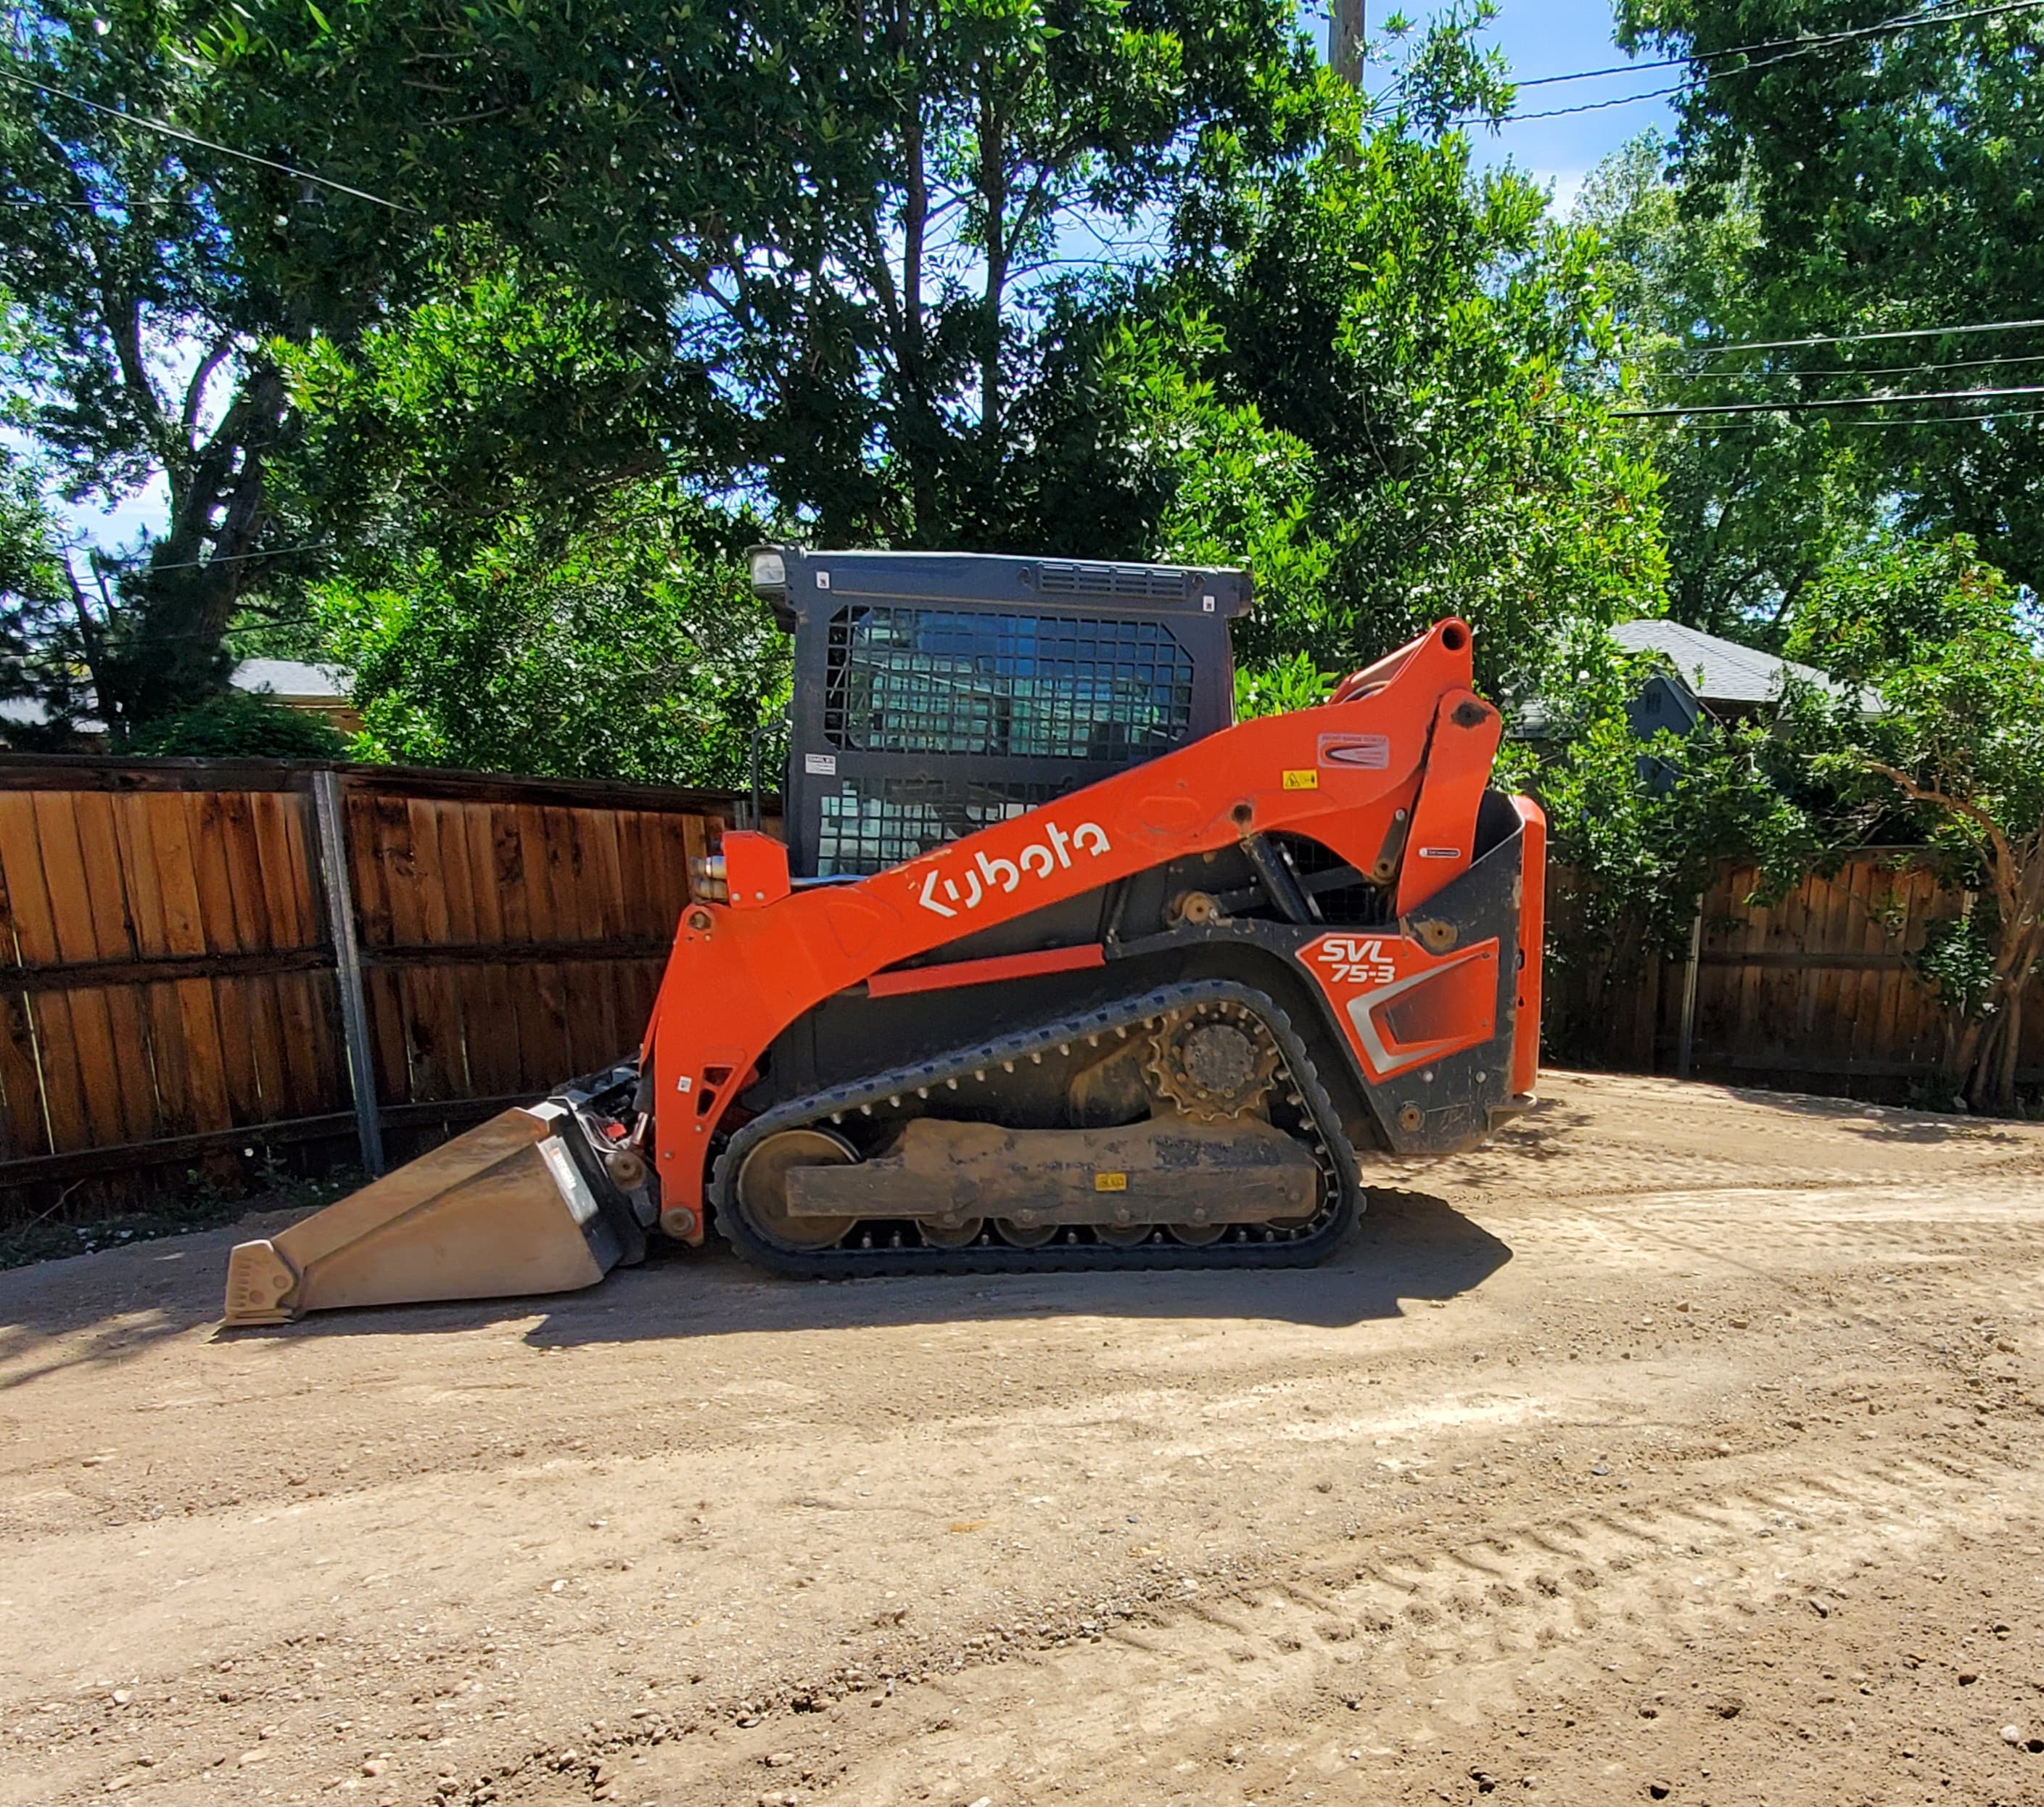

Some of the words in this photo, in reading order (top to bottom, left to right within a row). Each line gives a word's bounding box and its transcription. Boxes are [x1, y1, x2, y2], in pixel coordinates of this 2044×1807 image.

[919, 822, 1111, 917] Kubota
[1317, 939, 1393, 963] SVL
[1330, 963, 1396, 984] 75-3
